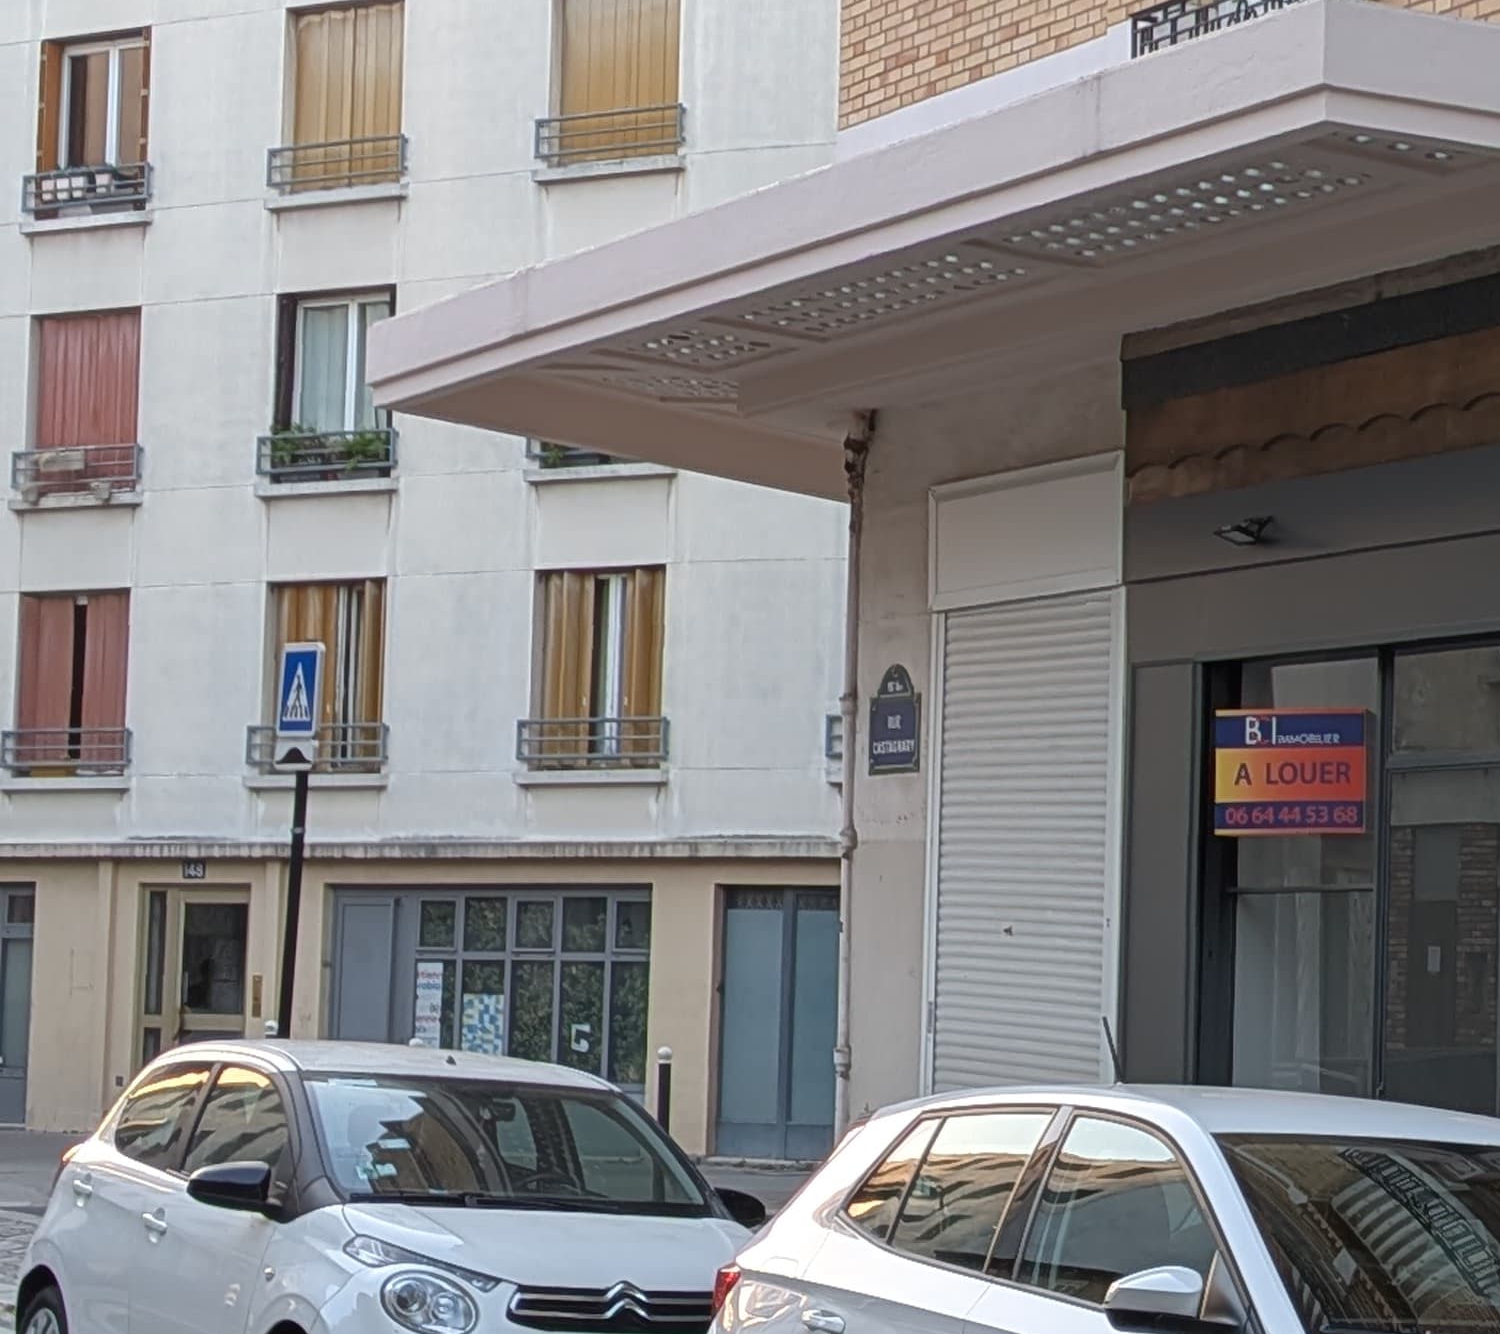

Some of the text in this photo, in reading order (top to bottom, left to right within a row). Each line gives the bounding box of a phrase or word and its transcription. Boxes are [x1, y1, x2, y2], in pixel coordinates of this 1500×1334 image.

[1234, 762, 1350, 786] A LOUER
[1225, 806, 1358, 825] 06 64 44 53 68
